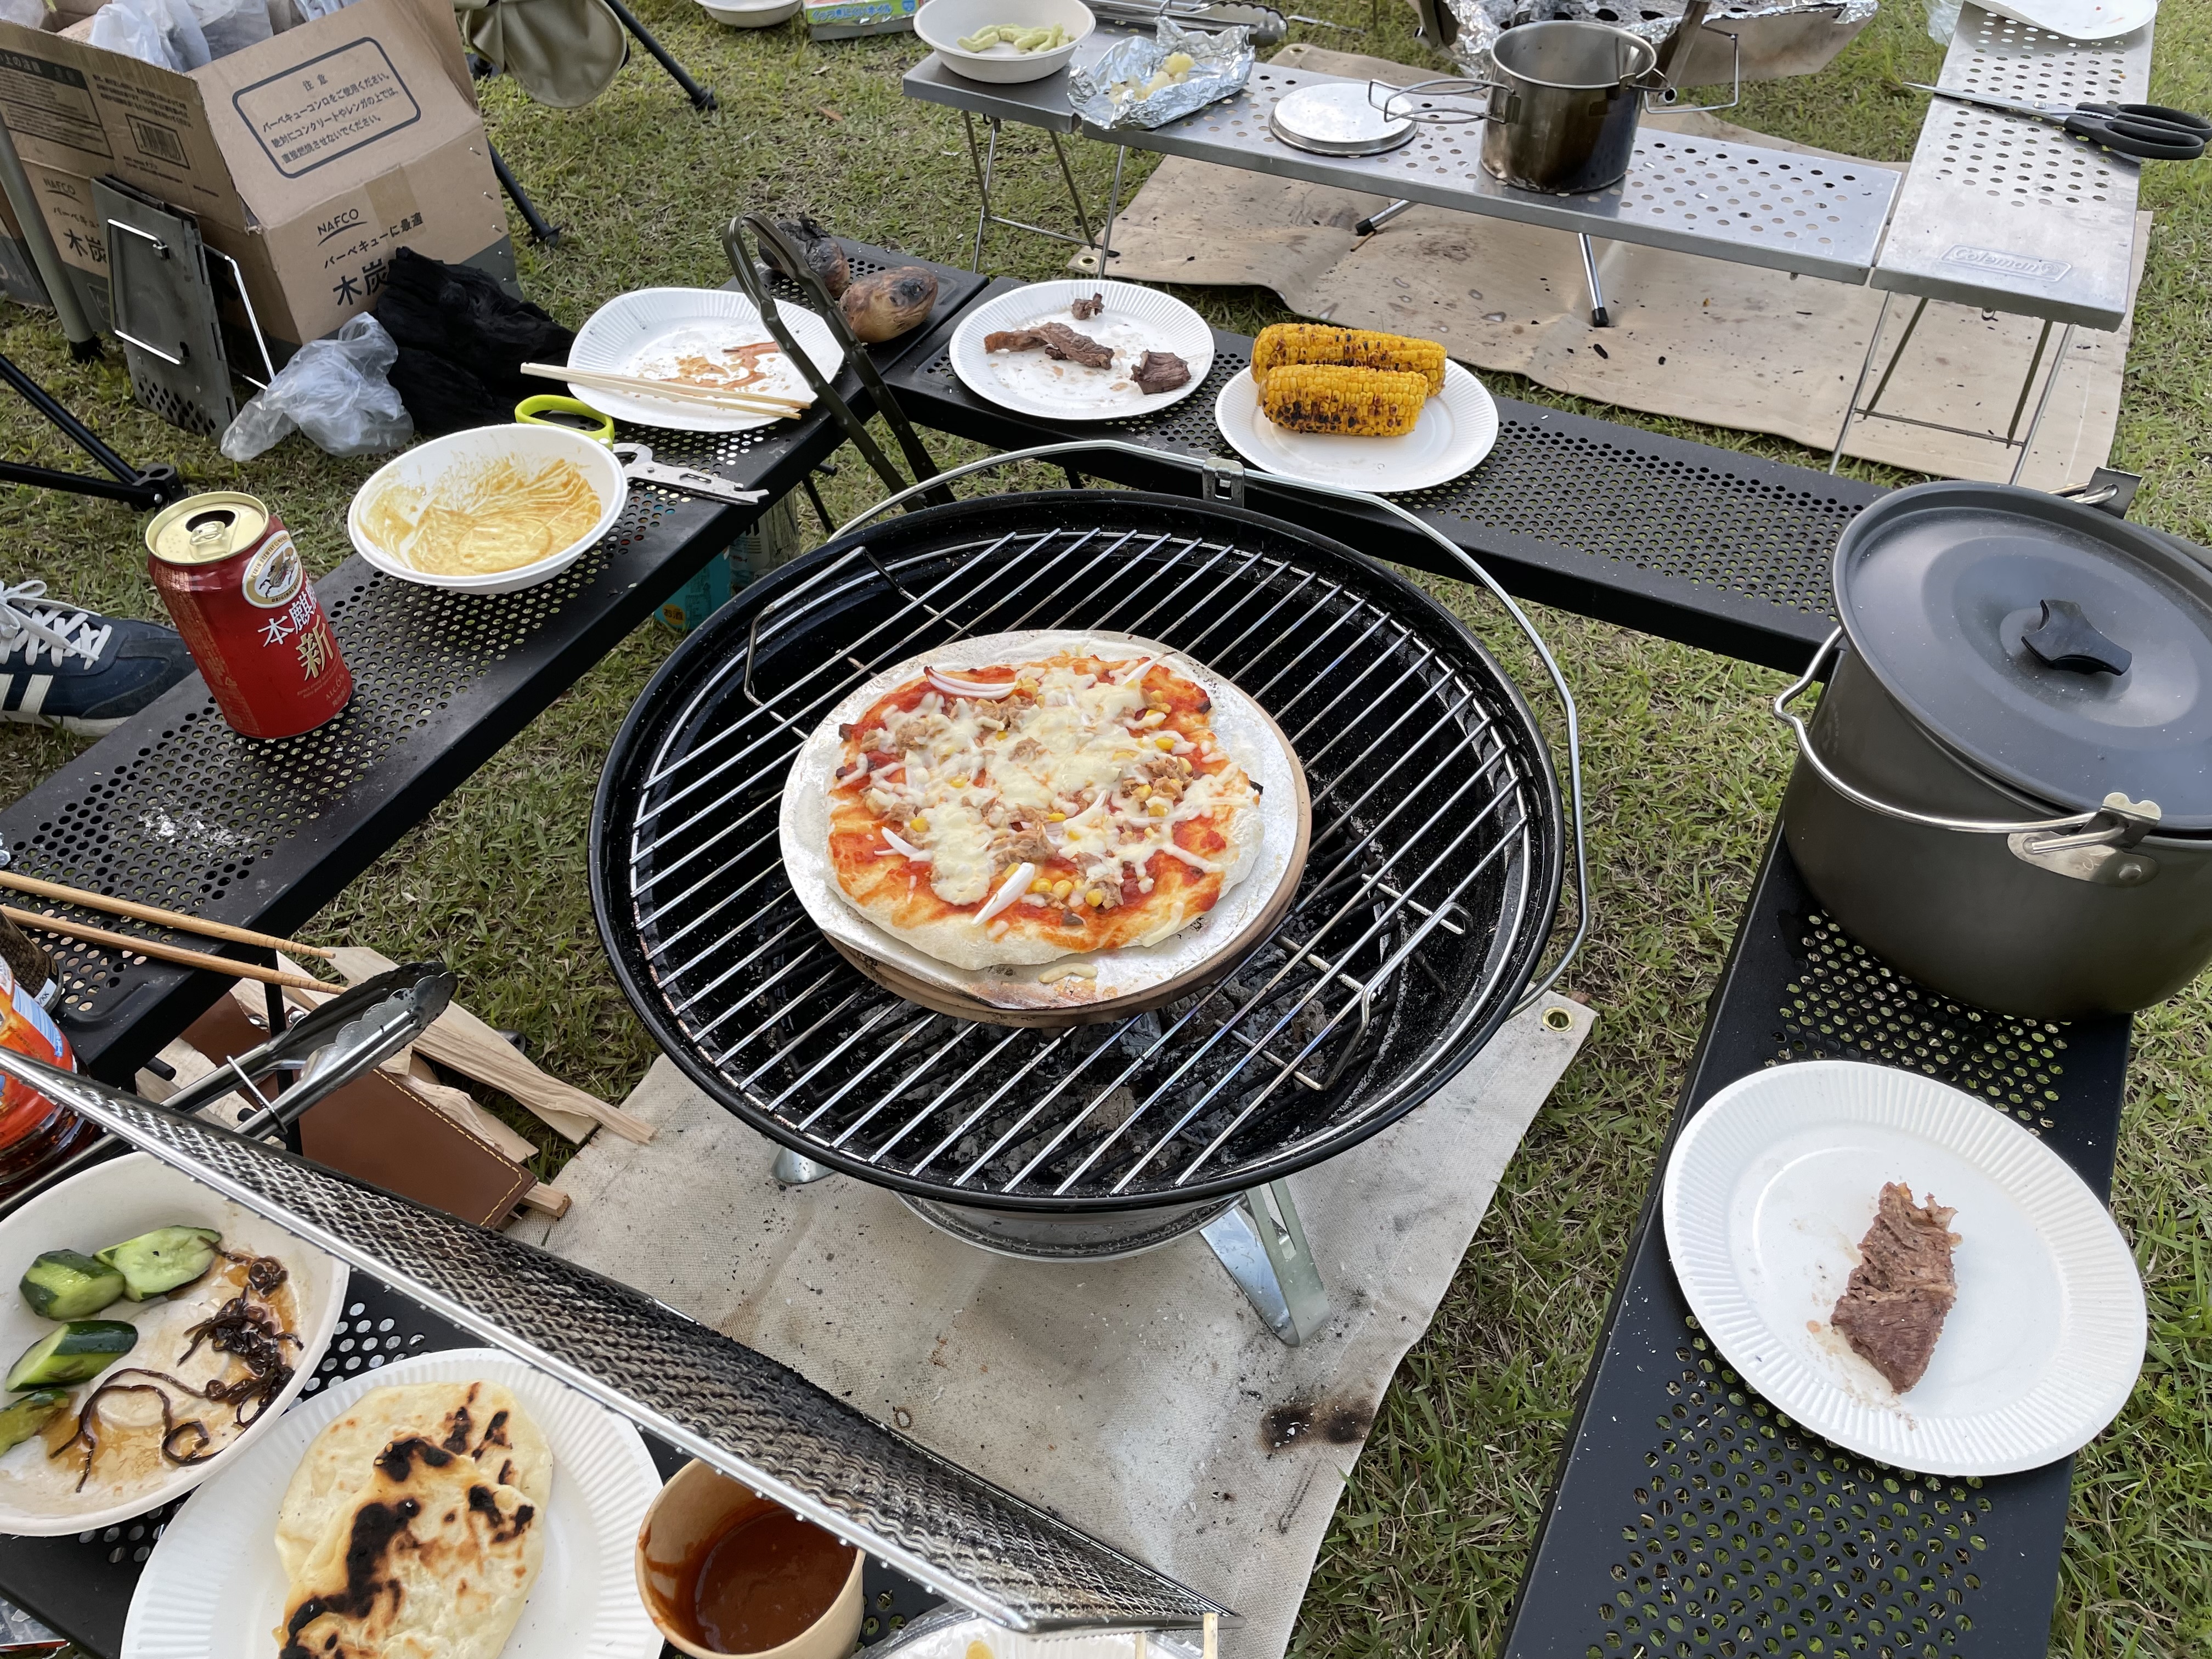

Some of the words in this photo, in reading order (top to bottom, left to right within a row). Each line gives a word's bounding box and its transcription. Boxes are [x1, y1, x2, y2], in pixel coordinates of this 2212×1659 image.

[317, 208, 359, 236] NAFCO
[324, 212, 424, 269] バーベキューに最適
[333, 258, 387, 306] 木炭
[1952, 249, 2039, 273] Coleman
[295, 614, 334, 681] 新
